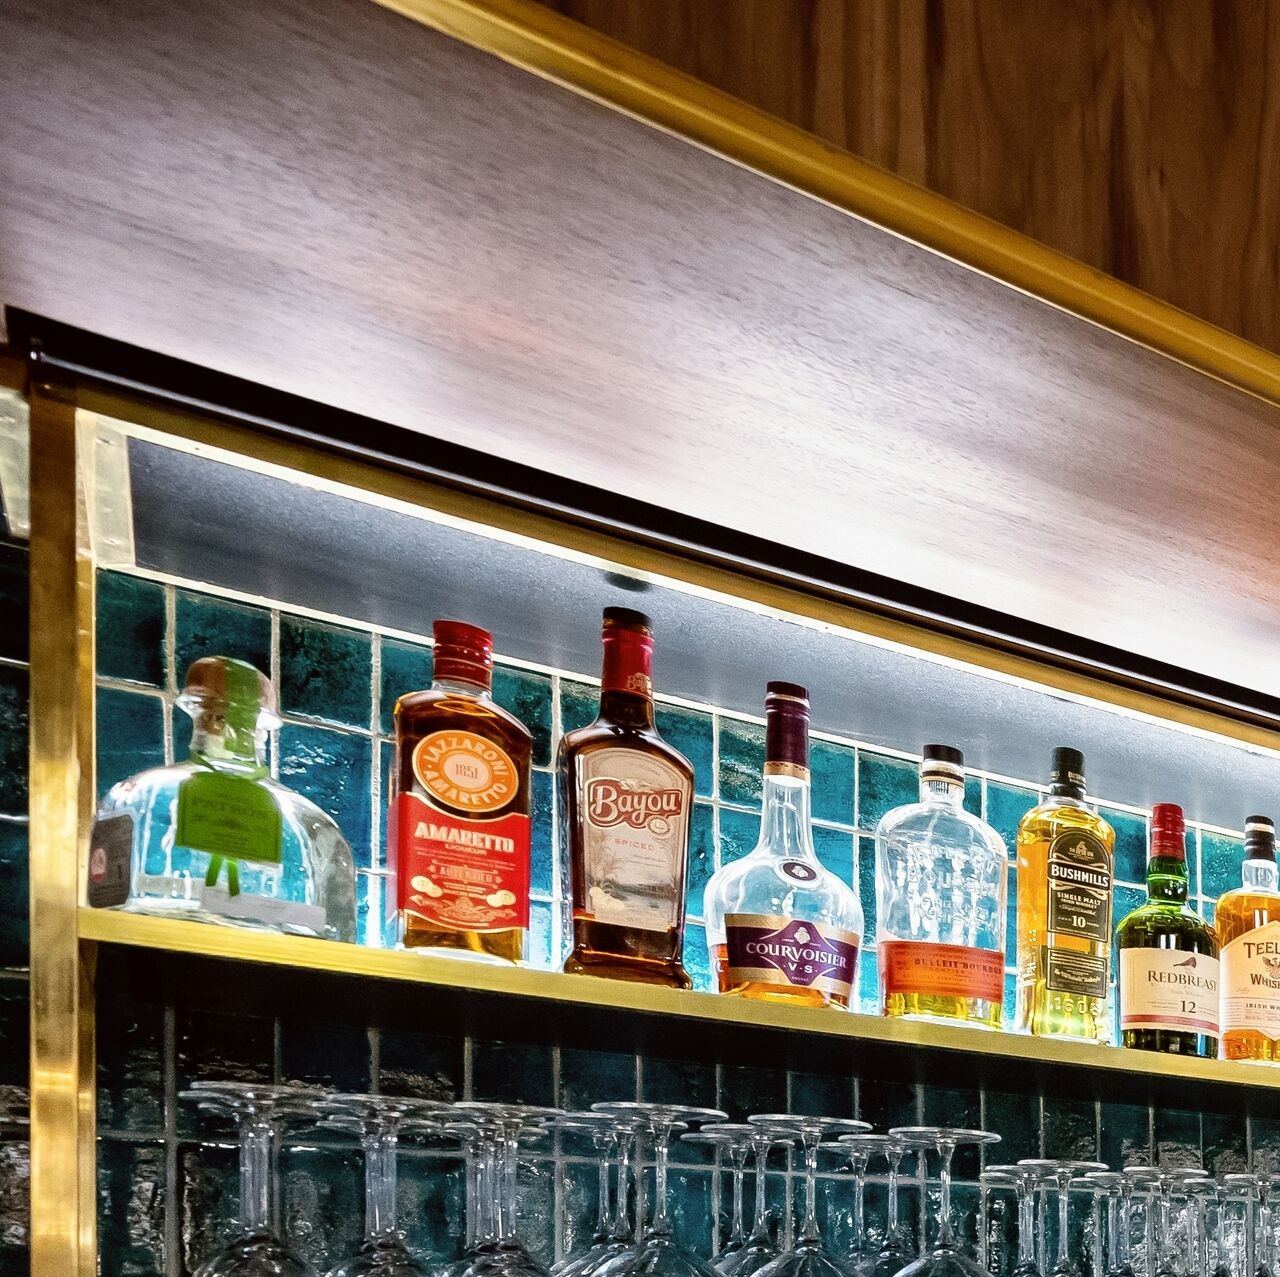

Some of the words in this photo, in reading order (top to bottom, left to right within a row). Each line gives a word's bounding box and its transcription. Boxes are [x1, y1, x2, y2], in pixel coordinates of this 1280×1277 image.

[422, 736, 510, 777] LAZZARONI
[423, 769, 509, 806] AMARETTO
[589, 784, 679, 826] Bayou
[414, 821, 515, 853] AMARETTO
[614, 837, 657, 850] SPICED
[1050, 863, 1109, 887] BUSHMILLS
[1056, 891, 1082, 902] SINGLE
[1083, 896, 1102, 906] MALT
[1071, 915, 1087, 928] 10
[745, 942, 848, 970] COURVOISIER
[913, 957, 959, 969] BULLEIT
[1147, 970, 1217, 992] REDBREAST
[1180, 1000, 1197, 1014] 12
[1245, 1002, 1268, 1010] IRISH
